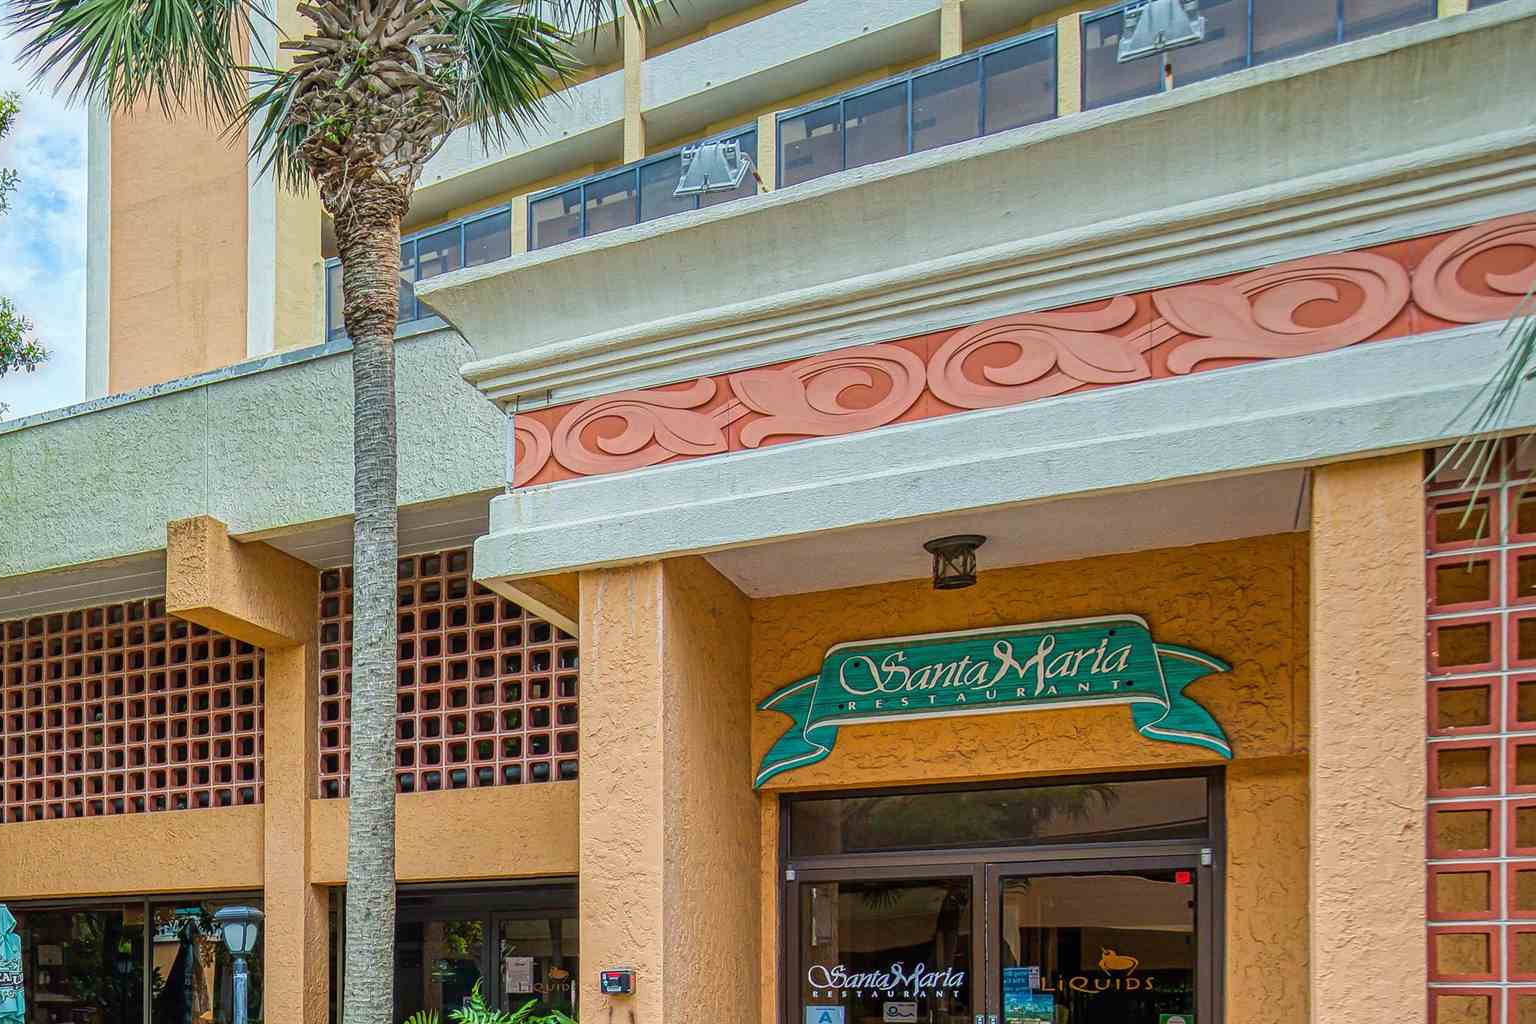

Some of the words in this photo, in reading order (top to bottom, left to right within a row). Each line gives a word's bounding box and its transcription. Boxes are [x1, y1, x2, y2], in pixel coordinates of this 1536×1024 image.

[840, 651, 990, 695] Santa
[971, 634, 1133, 697] Maria
[848, 680, 1121, 711] RESTAURANT
[808, 965, 891, 989] Santa
[879, 962, 965, 996] Maria
[812, 990, 960, 998] RESTAURANT
[818, 1011, 833, 1024] A
